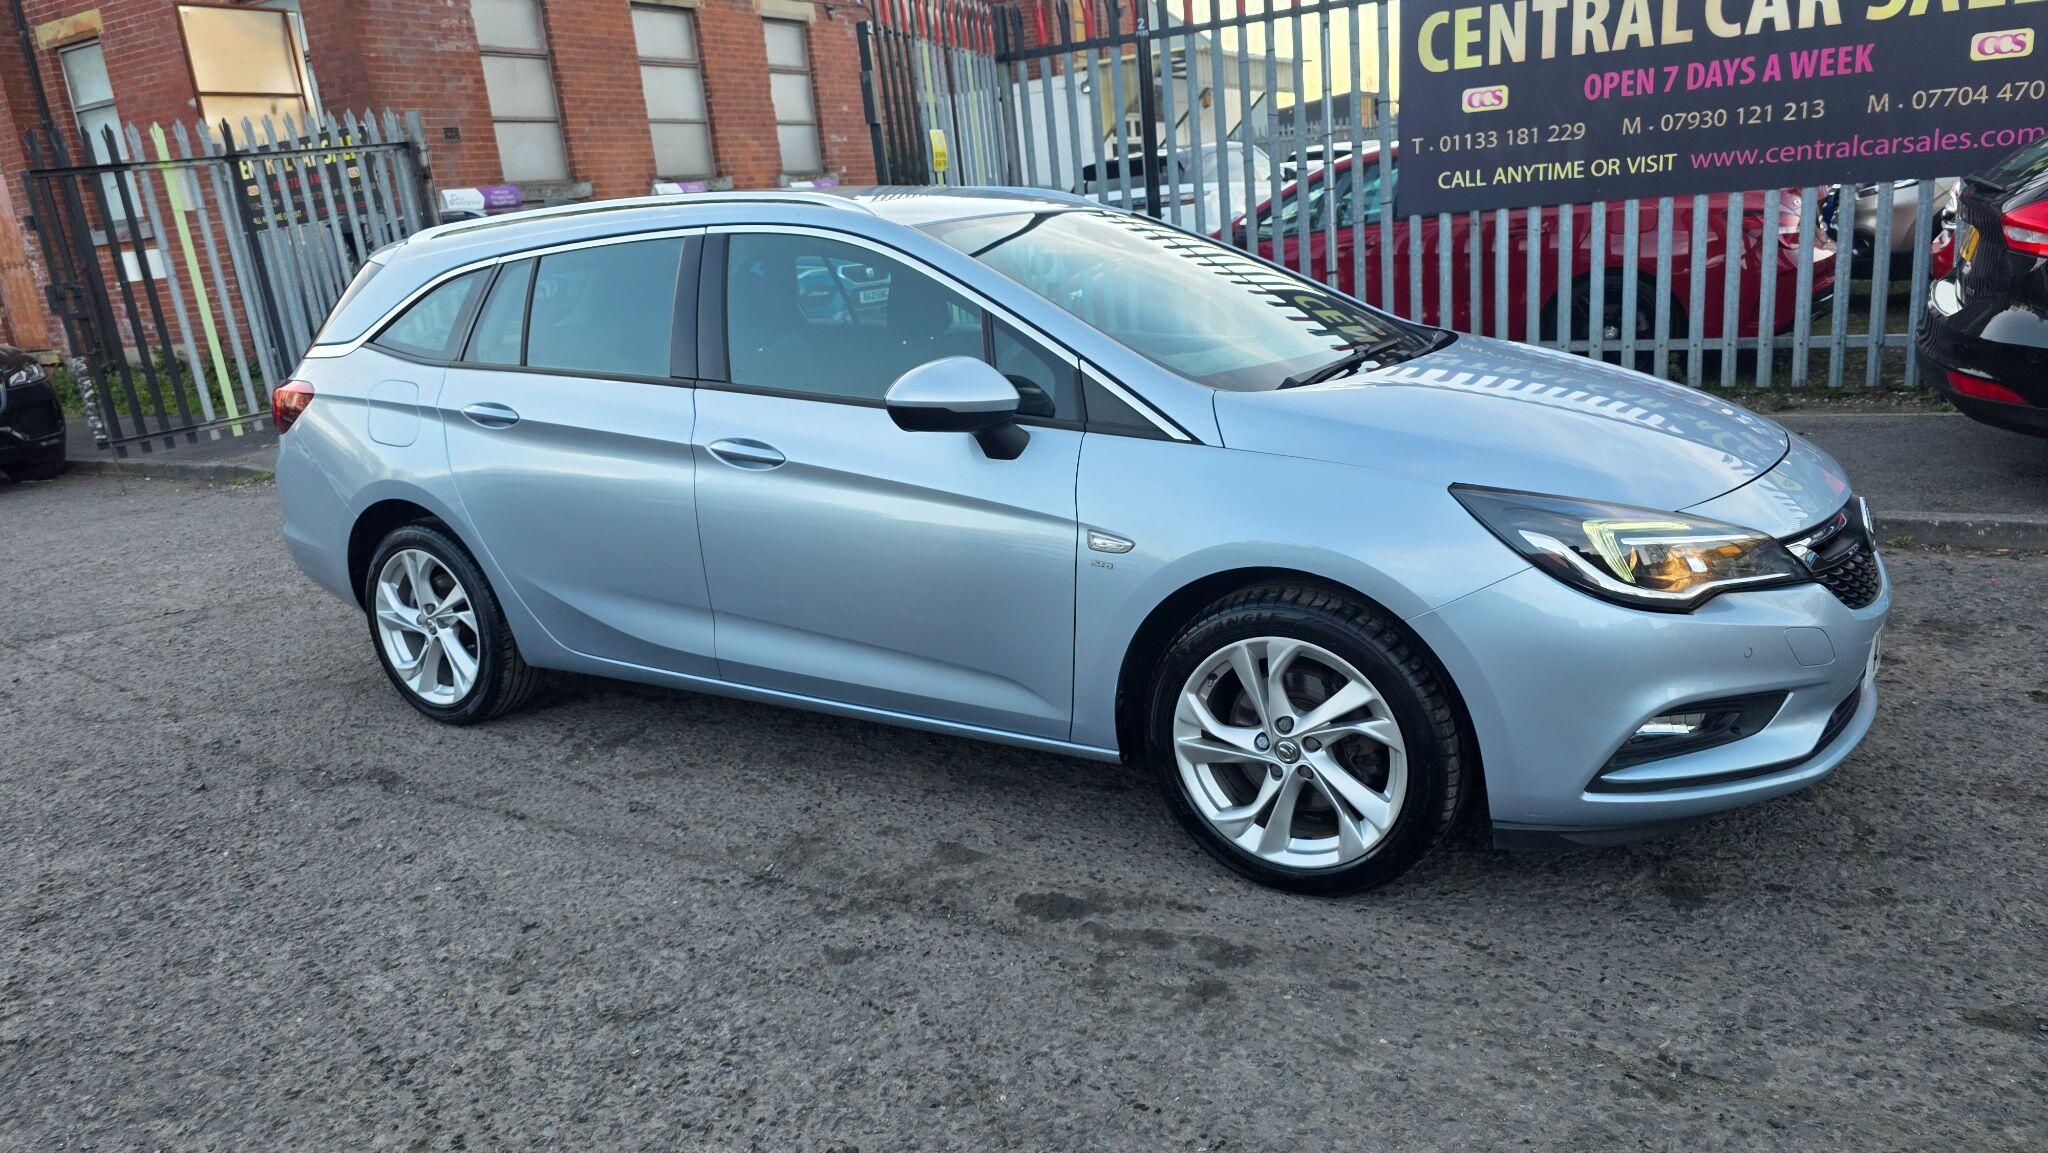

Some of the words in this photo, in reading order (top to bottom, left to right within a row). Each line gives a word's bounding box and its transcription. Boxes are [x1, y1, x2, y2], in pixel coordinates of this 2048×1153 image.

[1417, 0, 1694, 73] CENTRAL
[1583, 66, 1655, 101] OPEN
[1663, 65, 1680, 93] 7
[1686, 55, 1756, 91] DAYS
[1762, 53, 1782, 83] A
[1789, 43, 1876, 80] WEEK
[1912, 84, 1989, 110] 07704
[1996, 79, 2046, 102] 470
[1439, 130, 1499, 153] 01133
[1506, 127, 1539, 146] 181
[1547, 122, 1586, 142] 229
[1660, 108, 1728, 132] 07930
[1736, 104, 1773, 125] 121
[1782, 99, 1826, 121] 213
[1437, 169, 1487, 190] CALL
[1492, 160, 1586, 185] ANYTIME
[1590, 158, 1620, 177] OR
[1626, 153, 1679, 175] VISIT
[1690, 126, 2046, 170] www.centralcarsales.com
